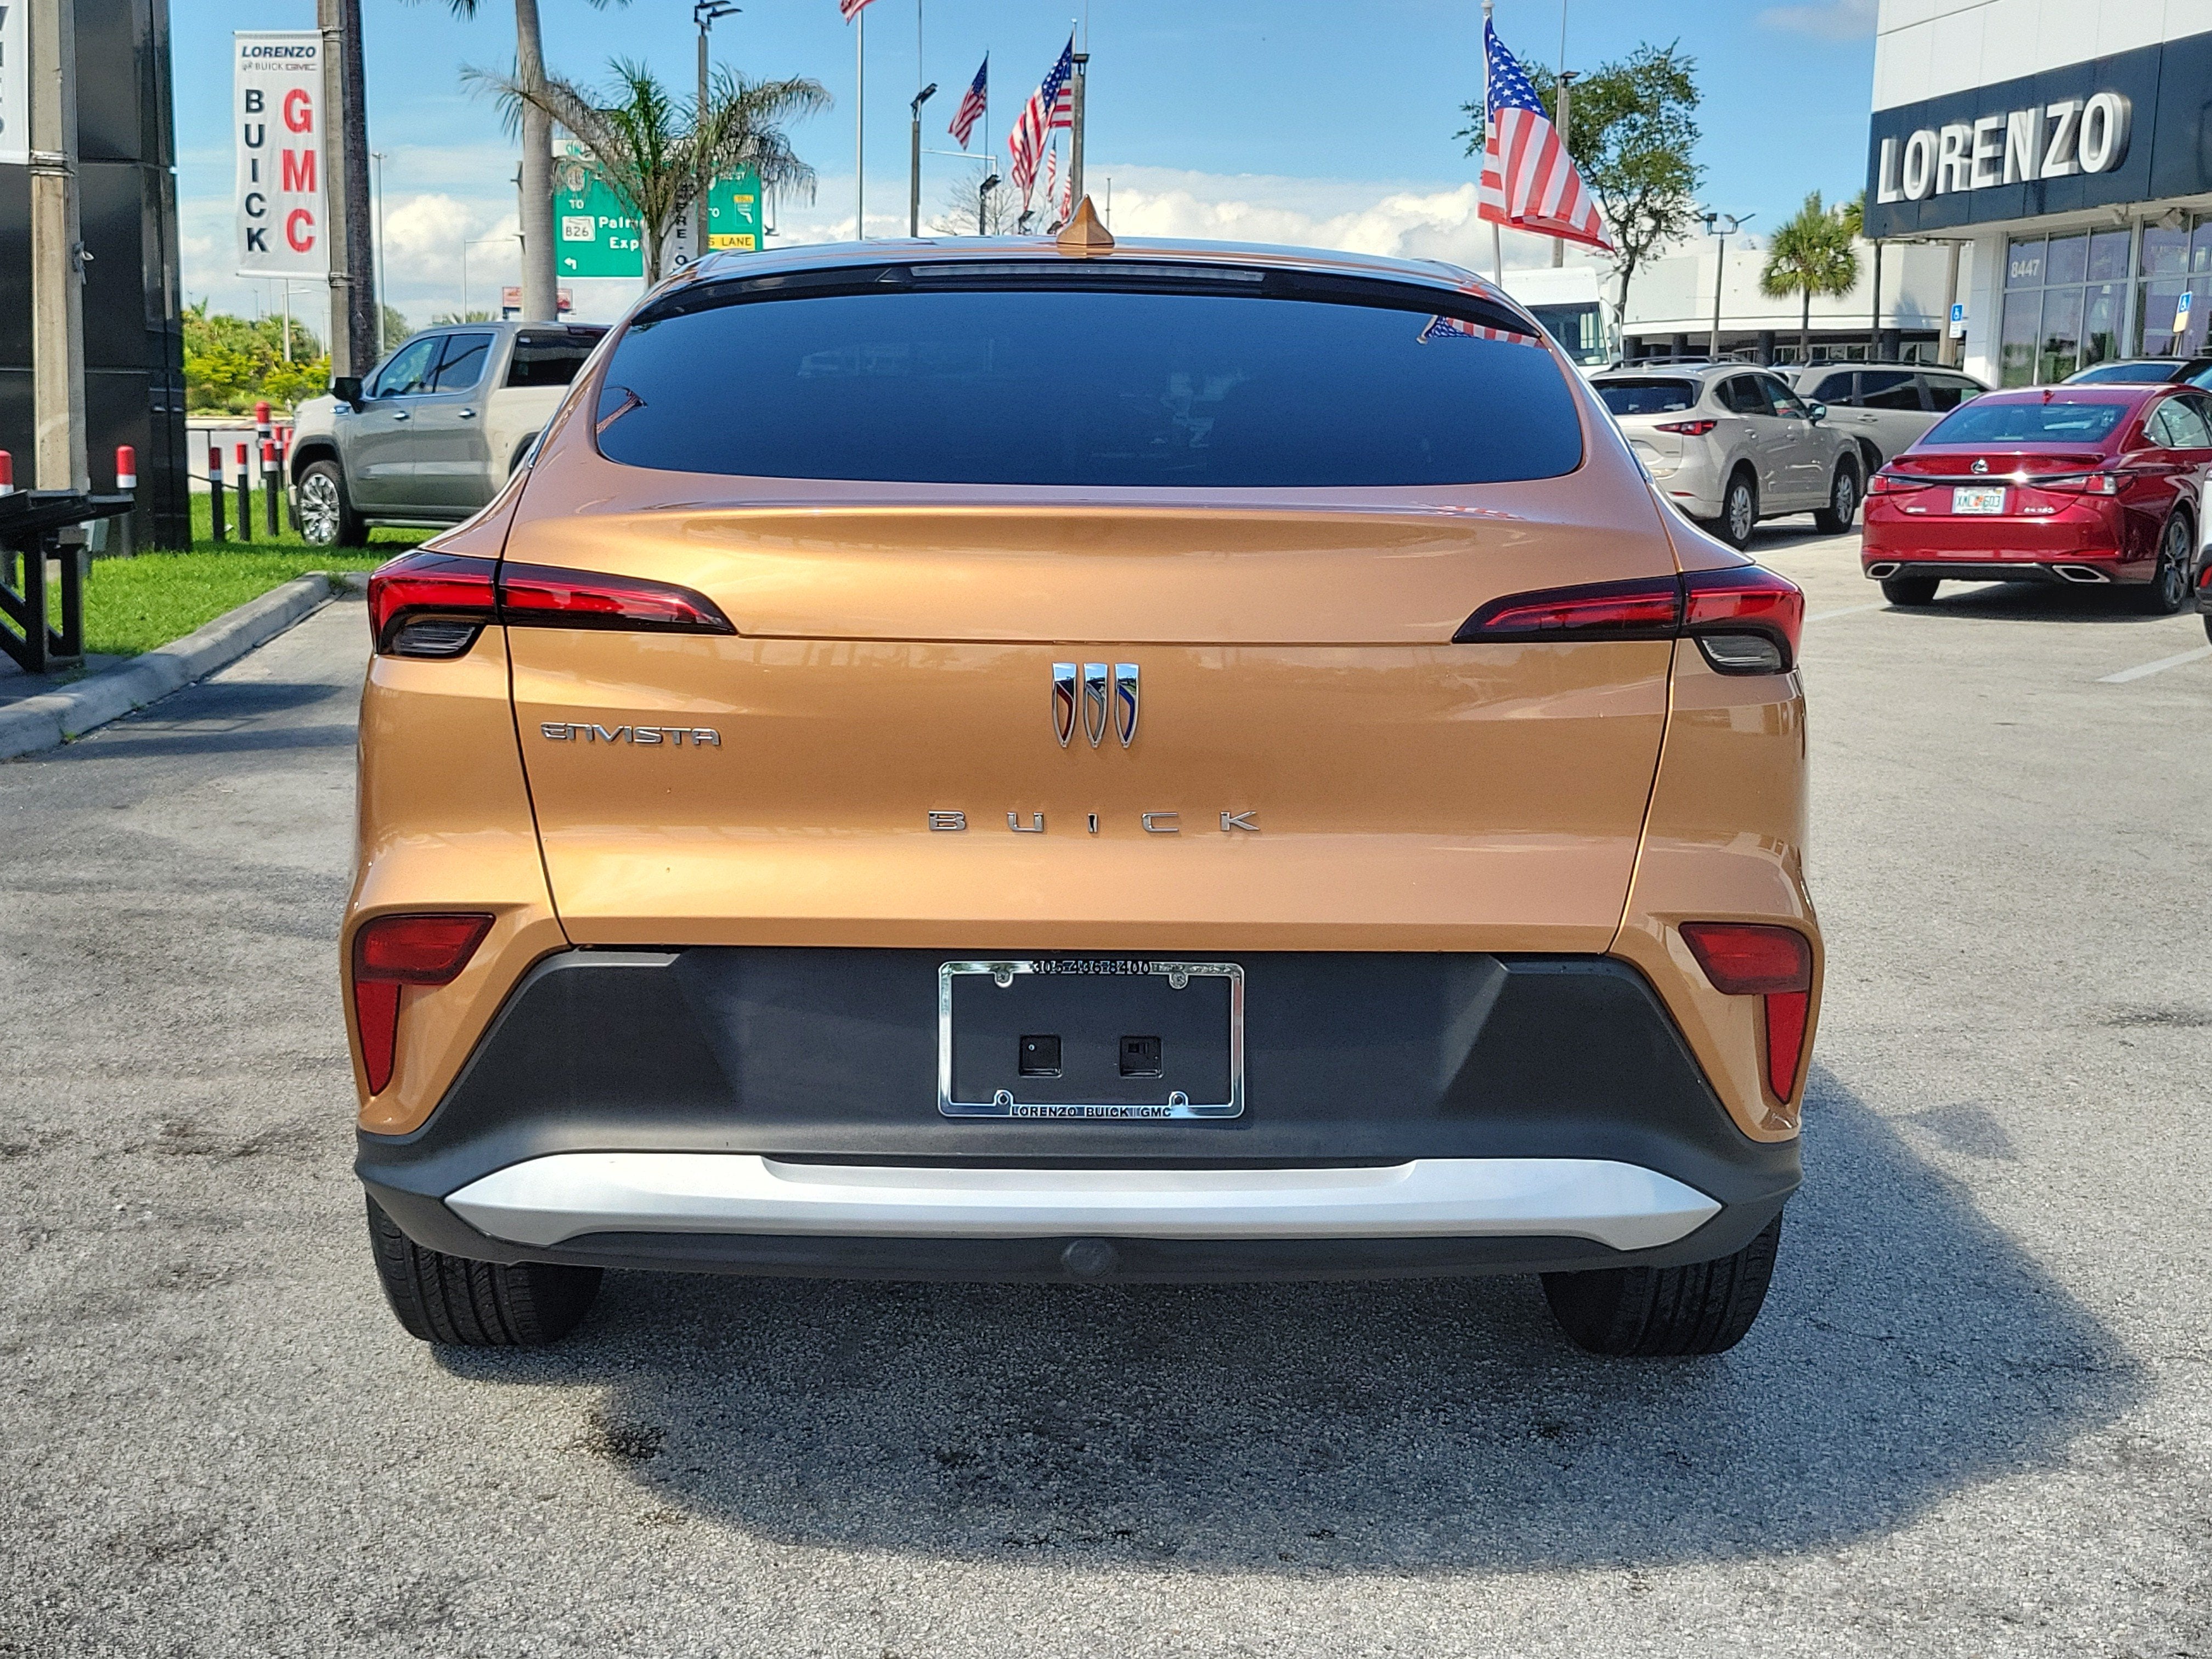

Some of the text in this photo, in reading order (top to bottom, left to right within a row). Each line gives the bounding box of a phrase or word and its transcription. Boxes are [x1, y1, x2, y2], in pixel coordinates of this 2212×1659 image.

[242, 46, 316, 58] LORENZO
[255, 61, 283, 71] BUICK
[1877, 92, 2132, 204] LORENZO
[245, 89, 269, 253] BUICK
[282, 88, 317, 253] GMC
[568, 199, 584, 210] TO
[721, 237, 752, 246] LANE
[2011, 259, 2041, 278] 8447
[540, 722, 721, 746] ENVISTA
[928, 810, 1260, 833] BUICK
[1011, 1107, 1172, 1118] LORENZO BUICK GMC
